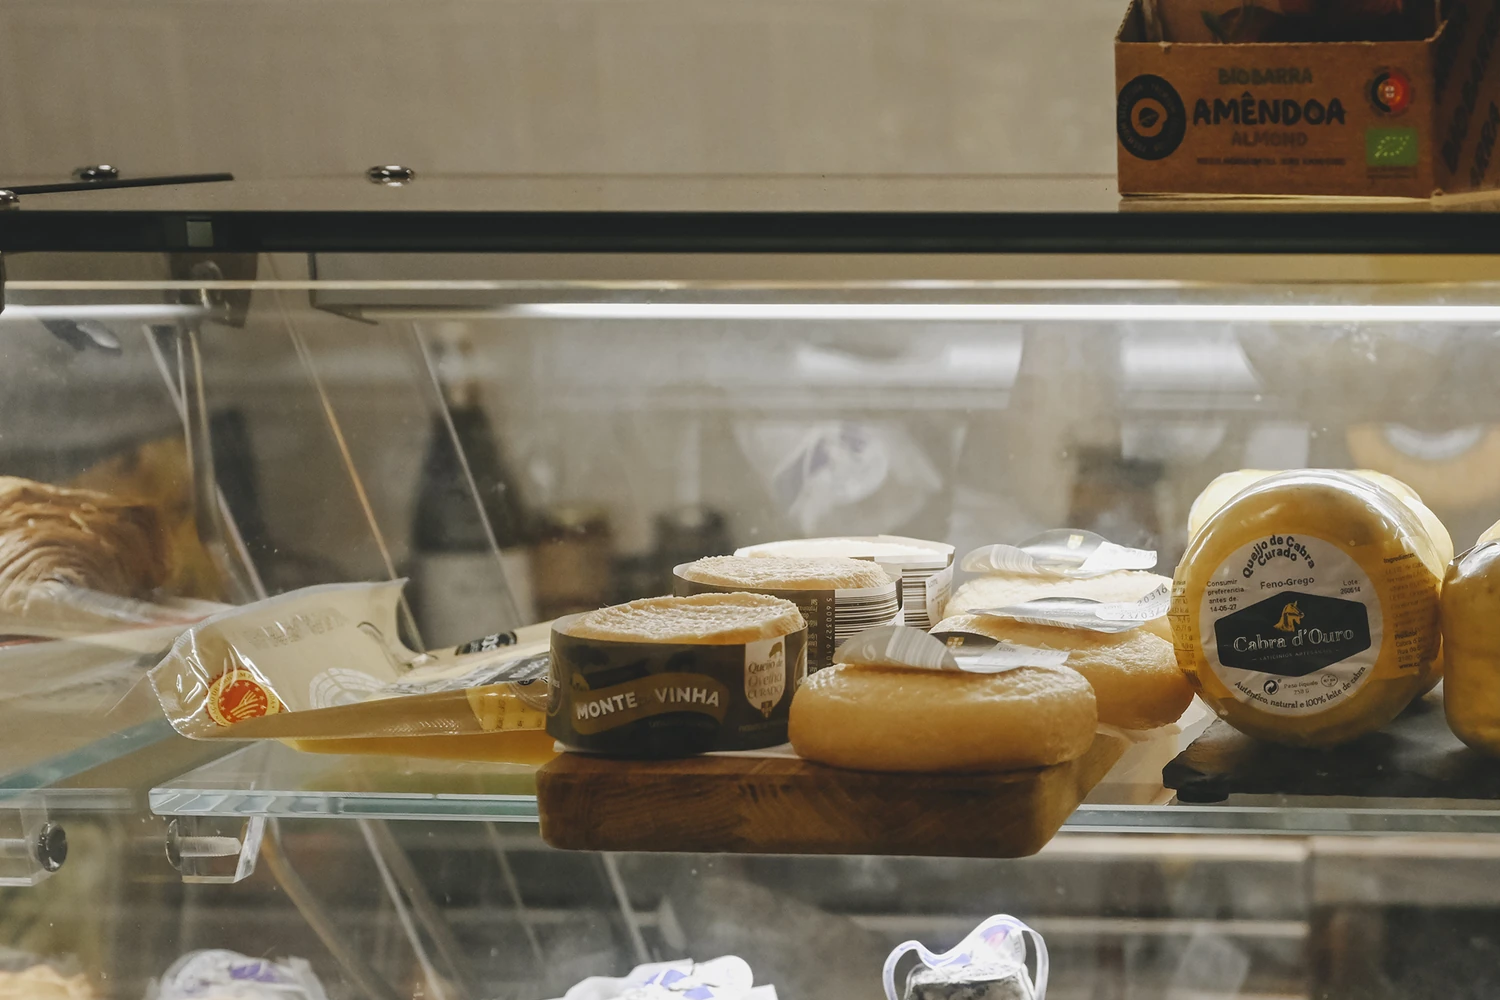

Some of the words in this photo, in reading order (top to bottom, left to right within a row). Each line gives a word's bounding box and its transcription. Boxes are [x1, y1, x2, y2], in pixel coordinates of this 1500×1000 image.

[1218, 68, 1313, 85] BIOBARRA
[1192, 91, 1347, 127] AMÊNDOA
[1231, 132, 1308, 147] ALMOND
[1242, 541, 1268, 578] Queijo
[1270, 535, 1284, 546] de
[1286, 536, 1315, 569] Cabra
[1258, 548, 1297, 567] Curado
[1206, 579, 1238, 588] Consumir
[1260, 577, 1315, 590] Feno-Grego
[1209, 597, 1227, 605] antes
[1233, 635, 1287, 653] Cabra
[1291, 628, 1354, 646] d'Ouro
[748, 660, 775, 675] Queijo
[1270, 699, 1298, 709] natural
[1305, 696, 1327, 708] 100%
[1325, 687, 1343, 703] leite
[1351, 666, 1367, 684] cabra
[577, 692, 637, 720] MONTE
[654, 687, 720, 707] VINHA
